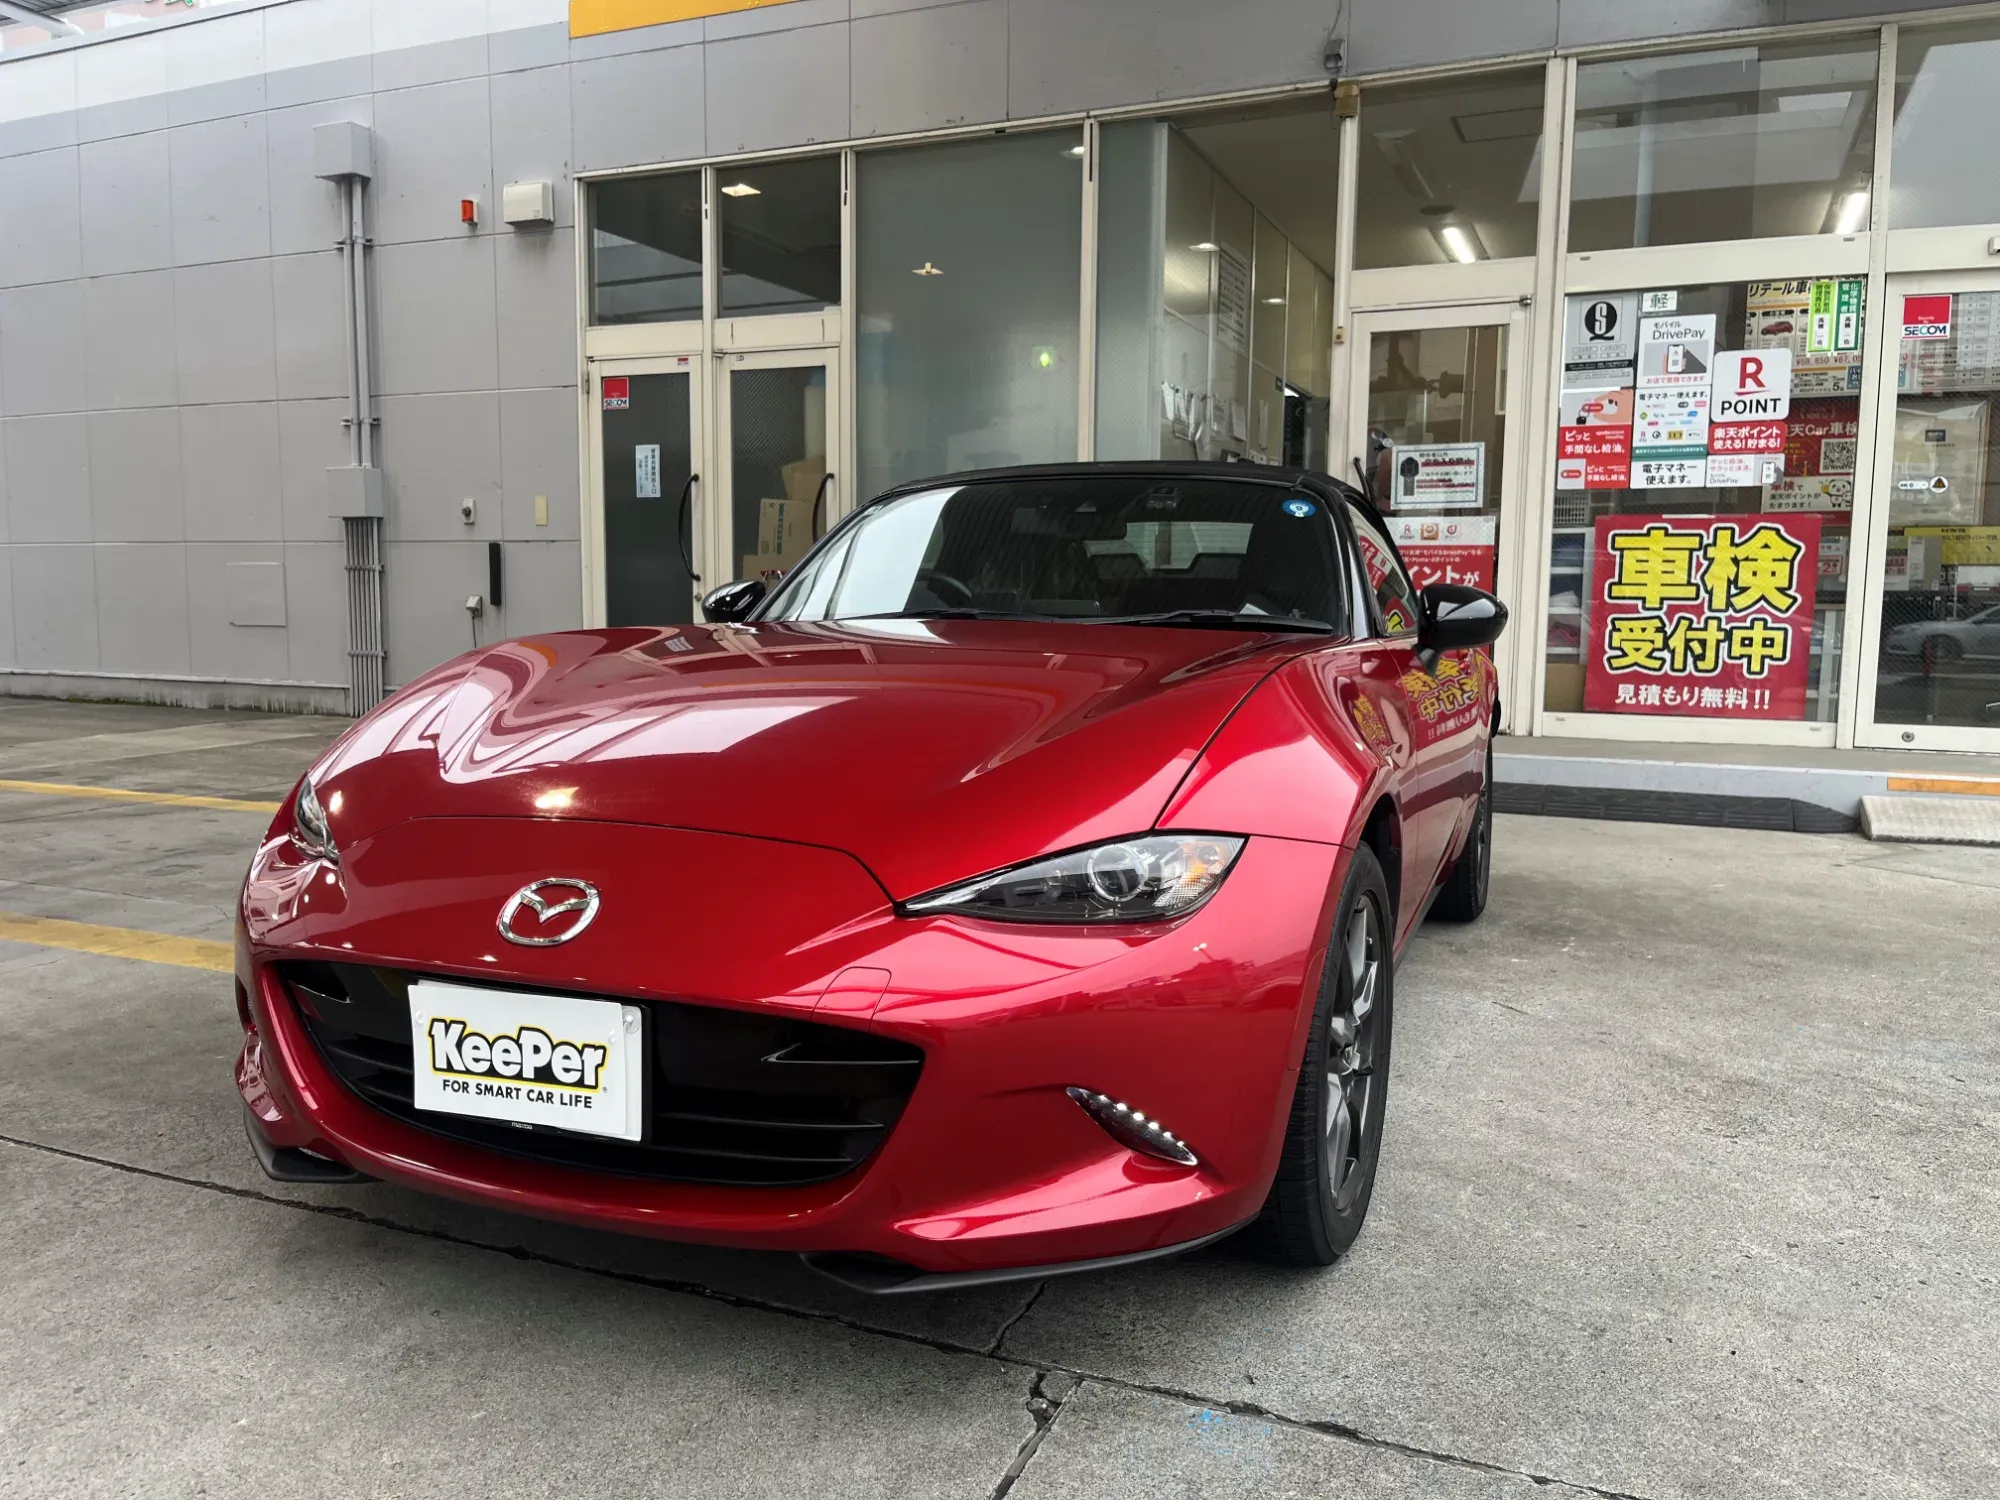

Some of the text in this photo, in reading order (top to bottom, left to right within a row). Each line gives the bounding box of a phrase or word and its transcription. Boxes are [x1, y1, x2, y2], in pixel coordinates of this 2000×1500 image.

[1749, 280, 1811, 297] リテール車
[1653, 321, 1681, 329] モバイル
[1904, 325, 1947, 336] SECOM
[1652, 328, 1706, 340] DrivePay
[1739, 356, 1766, 389] R
[604, 399, 627, 407] SECOM
[1720, 398, 1782, 415] POINT
[1565, 430, 1591, 442] ピッと
[1713, 426, 1781, 439] 楽天ポイント
[1642, 463, 1697, 474] 電子マネー
[1645, 474, 1691, 485] 使えます。
[1606, 524, 1804, 616] 車検
[1606, 614, 1790, 676] 受付中
[430, 1018, 607, 1089] KeePer
[442, 1079, 593, 1109] FOR SMART CAR LIFE
